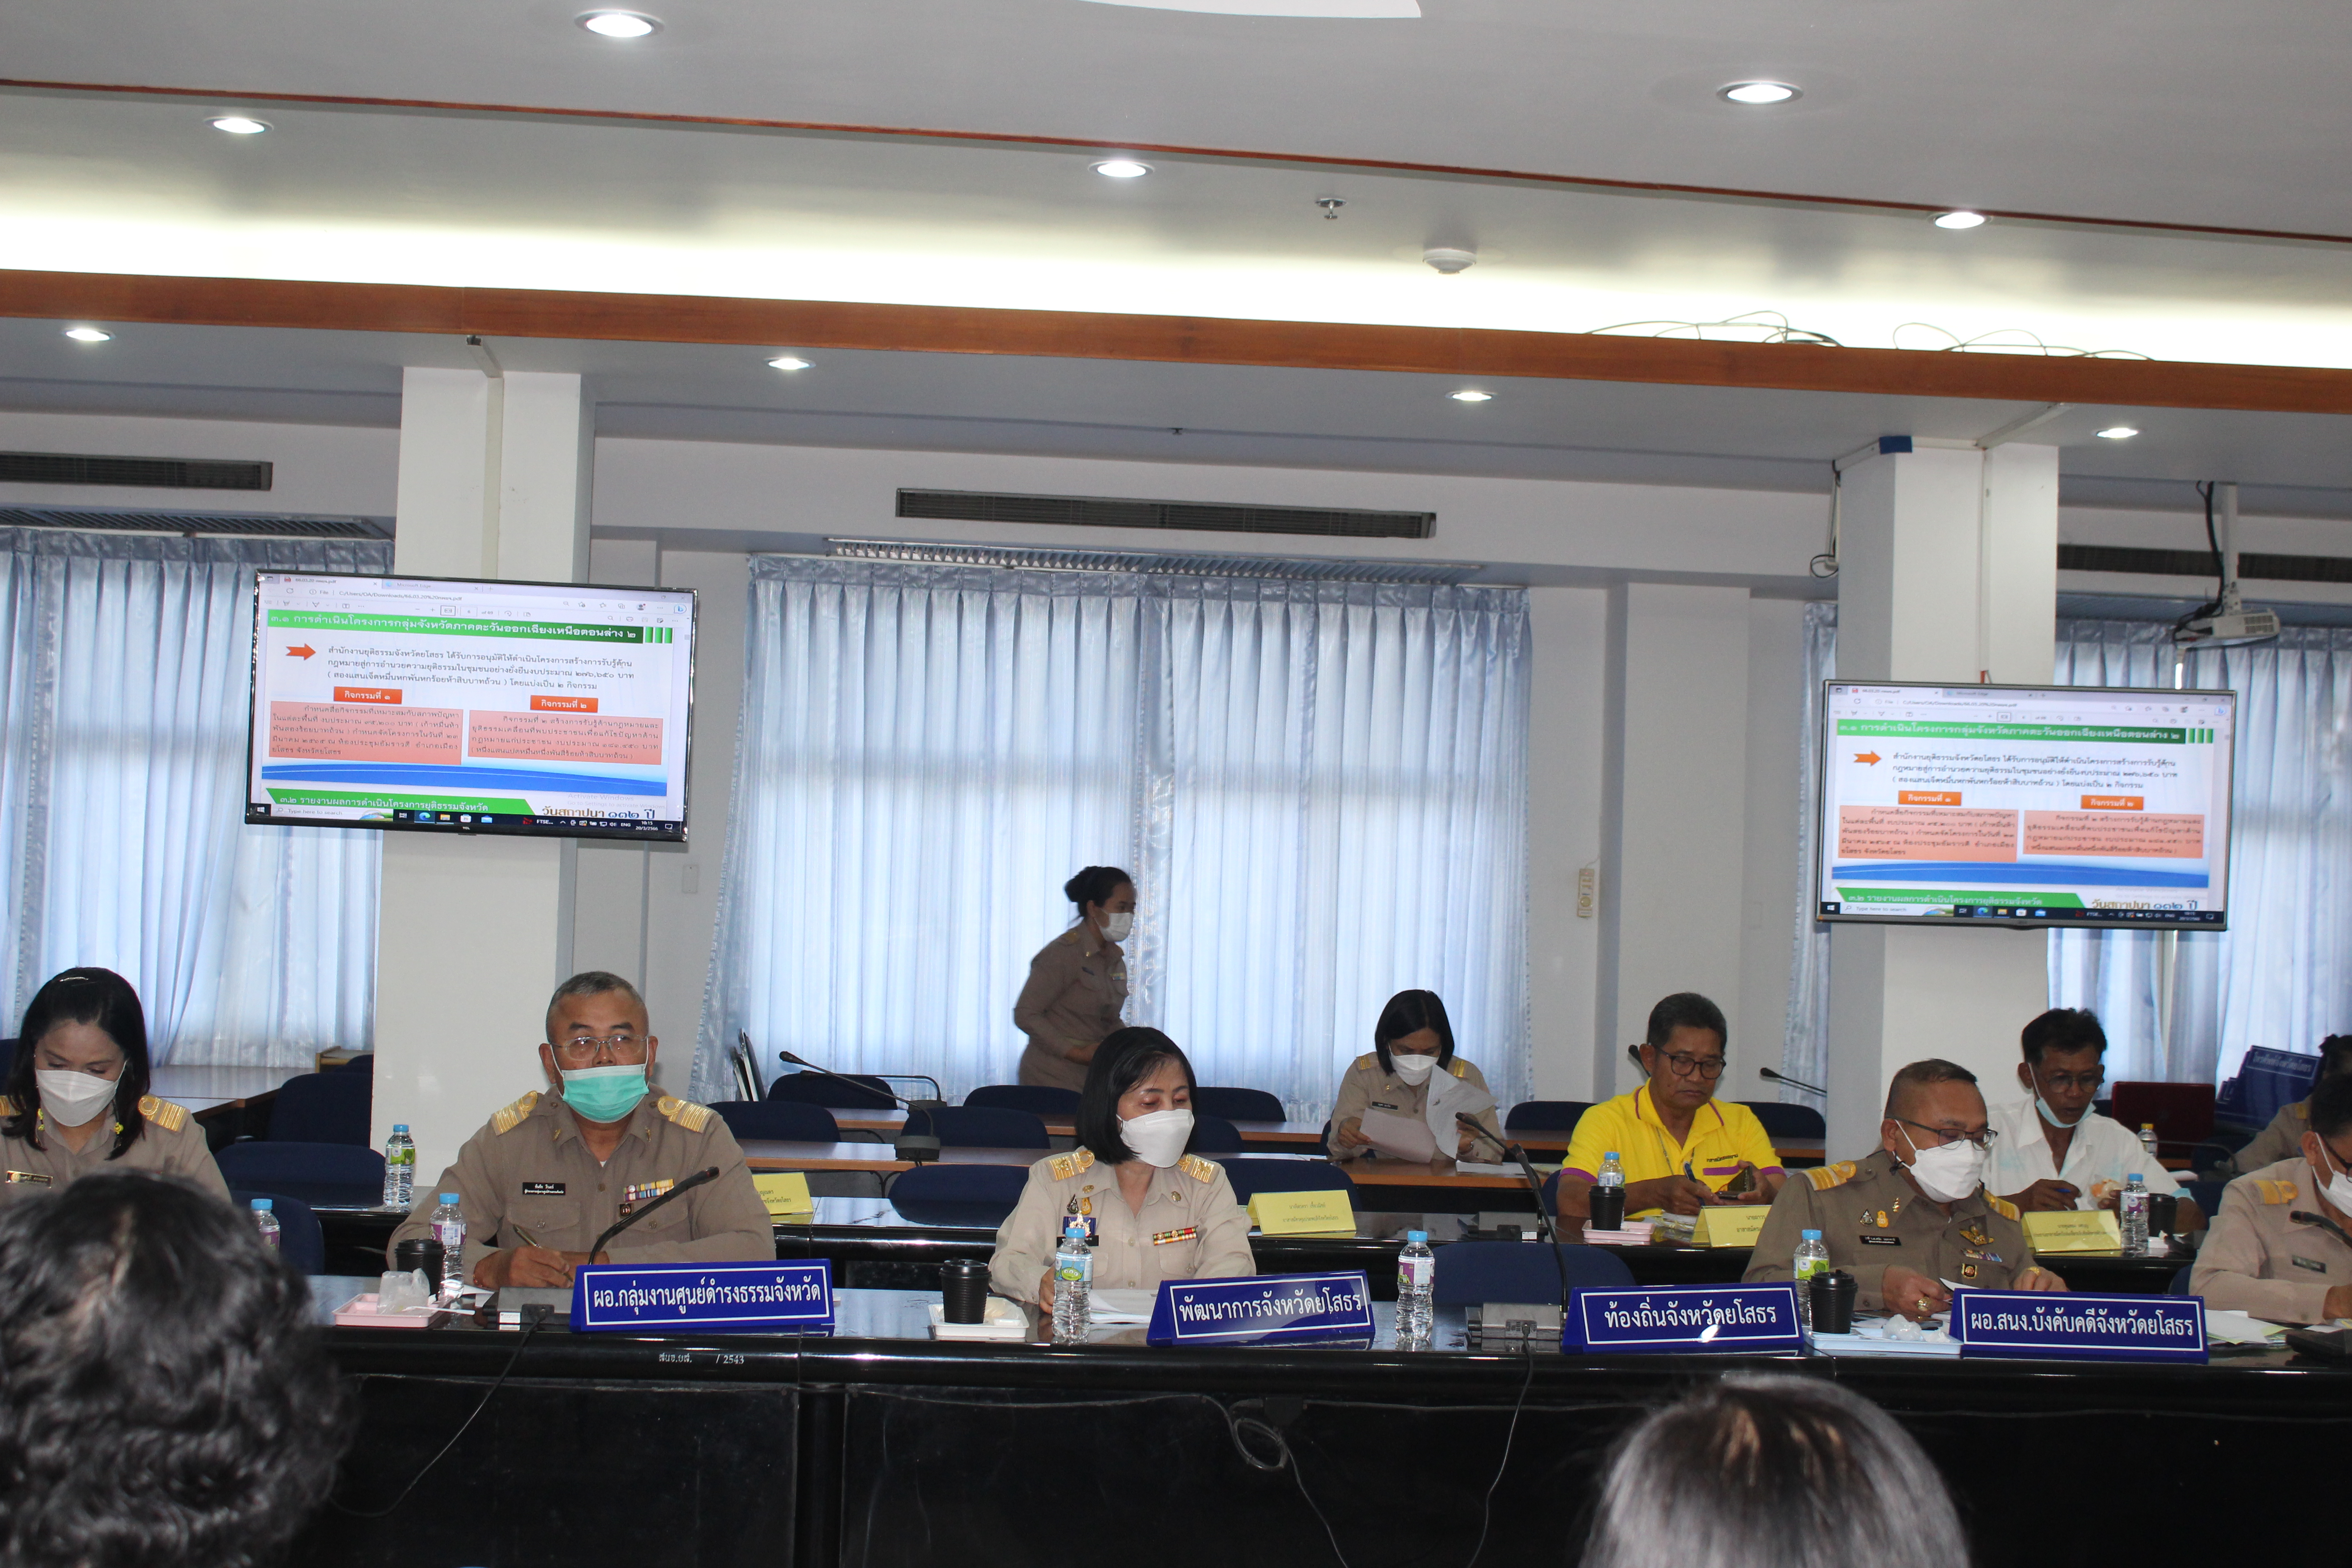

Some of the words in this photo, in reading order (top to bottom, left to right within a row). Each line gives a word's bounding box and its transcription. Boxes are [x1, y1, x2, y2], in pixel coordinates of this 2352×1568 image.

[626, 630, 636, 638] ๒
[328, 647, 444, 658] สำนักงานยุติธรรมจังหวัดยโสธร
[510, 678, 554, 688] โดยแบ่งเป็น
[567, 681, 597, 690] กิจกรรม
[344, 690, 381, 700] กิจกรรมที่
[541, 698, 578, 708] กิจกรรมที่
[503, 713, 539, 723] กิจกรรมที่
[556, 739, 599, 747] งบประมาณ
[272, 744, 294, 753] ยโสธร
[296, 745, 342, 755] จังหวัดยโสธร
[593, 1274, 821, 1315] ผอ.กลุ่มงานศูนย์ดำรงธรรมจังหวัด
[1179, 1287, 1362, 1322] พัฒนาการจังหวัดยโสธร
[1604, 1296, 1777, 1328] ท้องถิ่นจังหวัดยโสธร
[1971, 1306, 2193, 1336] ผอ.สนง.บังคับคดีจังหวัดยโสธร
[723, 1354, 745, 1364] 2543
